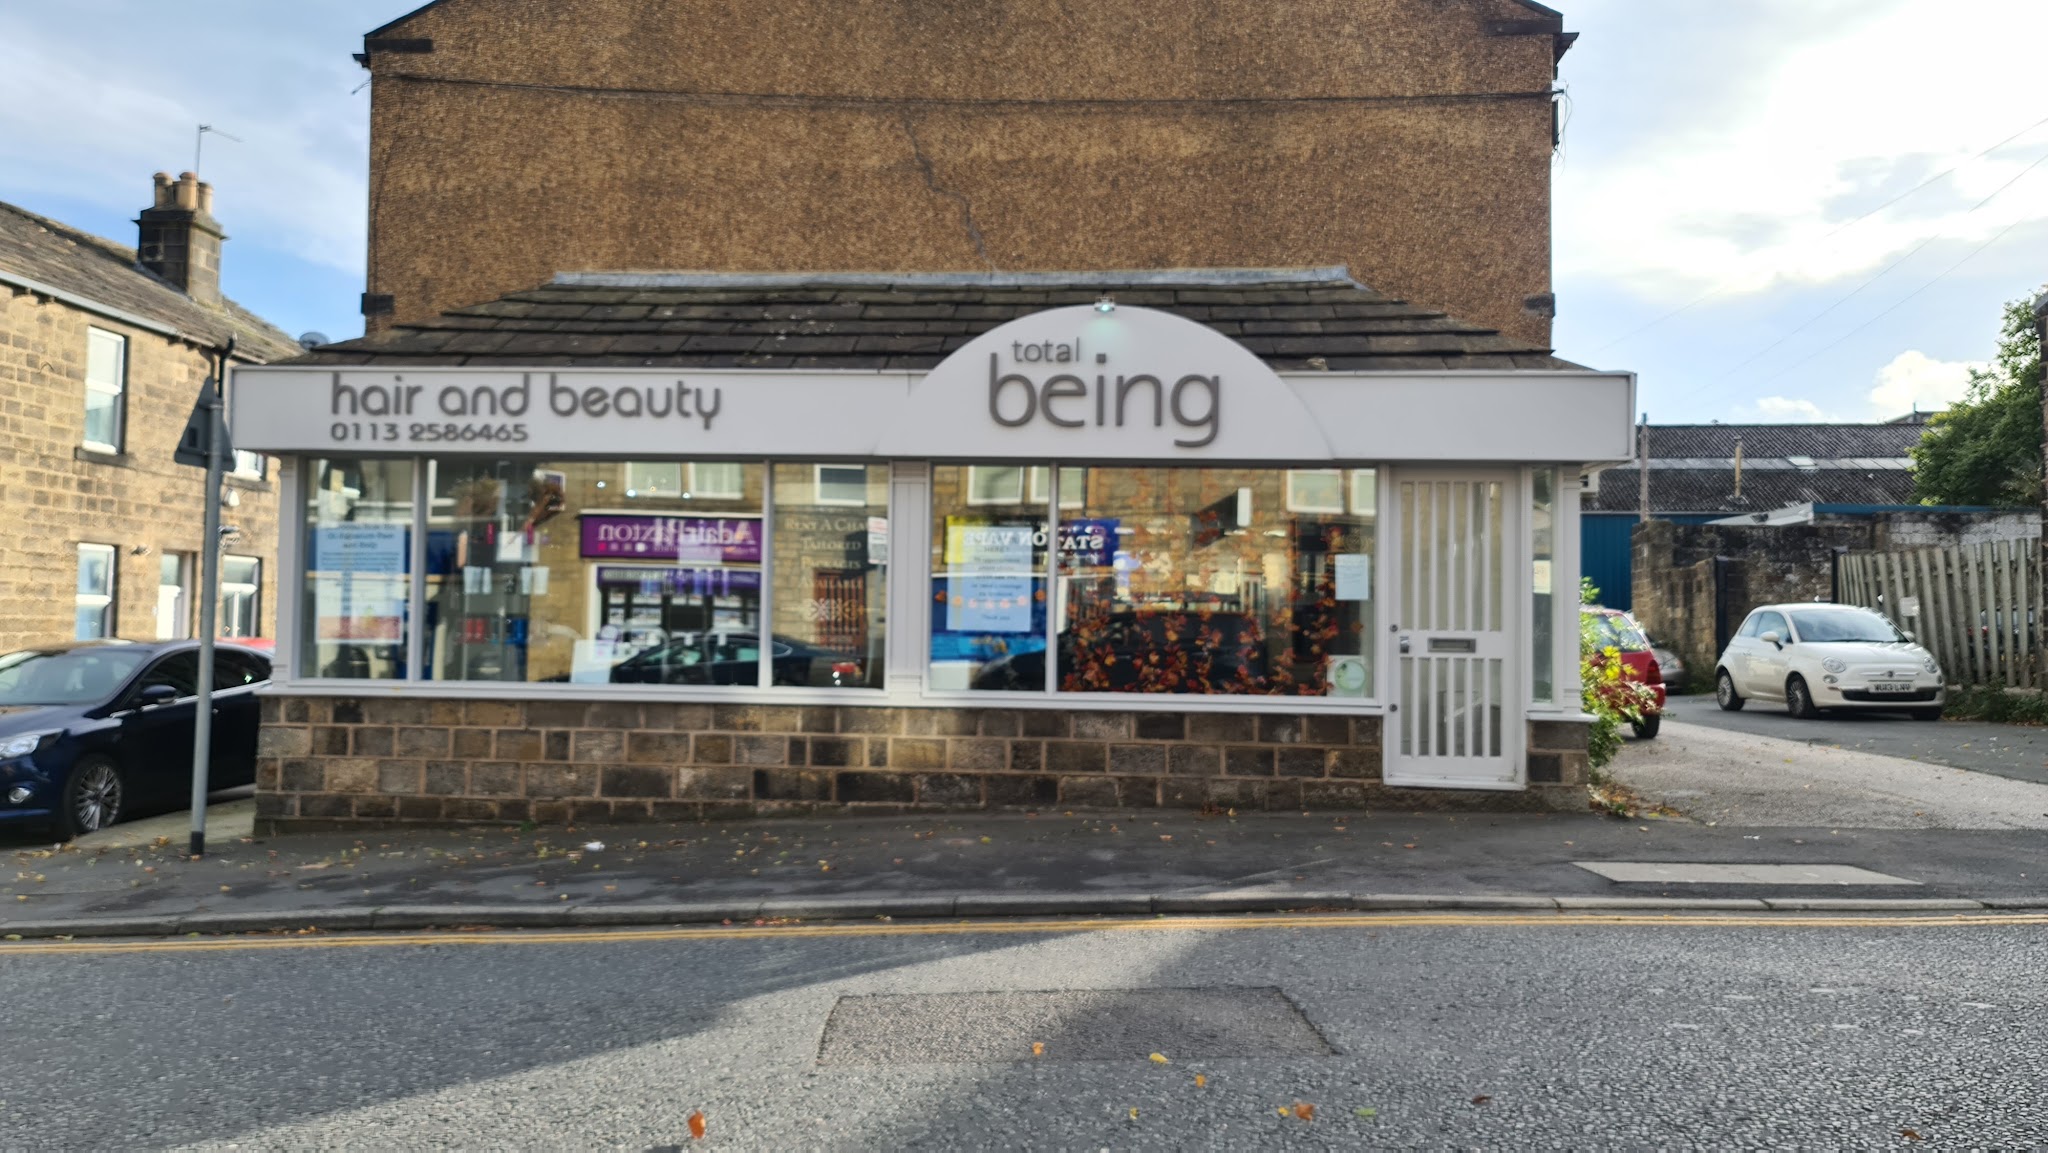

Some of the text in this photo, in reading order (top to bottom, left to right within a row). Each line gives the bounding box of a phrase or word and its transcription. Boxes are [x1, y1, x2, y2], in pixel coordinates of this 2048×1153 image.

[1012, 337, 1081, 365] total
[331, 372, 722, 431] hair and beauty
[988, 353, 1221, 447] being
[330, 422, 529, 443] 0113 2586465
[822, 519, 833, 531] A
